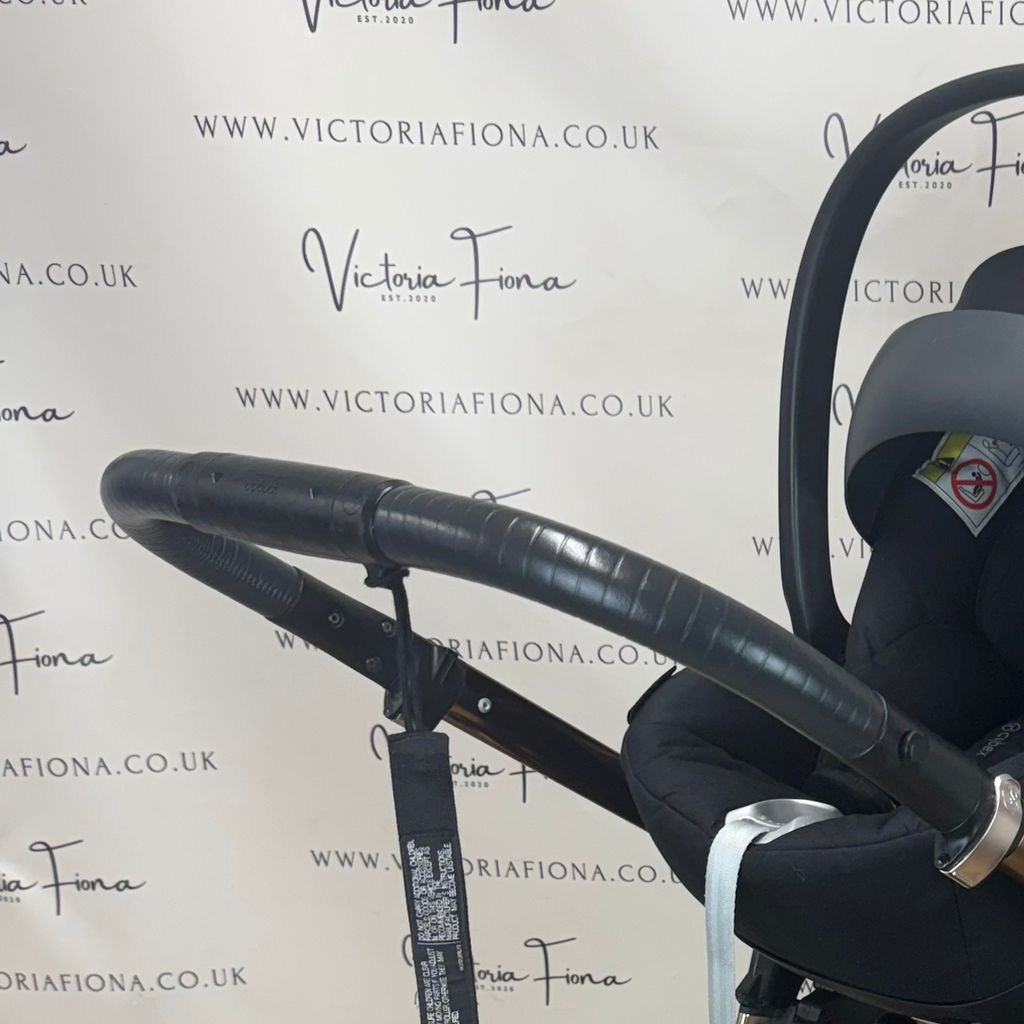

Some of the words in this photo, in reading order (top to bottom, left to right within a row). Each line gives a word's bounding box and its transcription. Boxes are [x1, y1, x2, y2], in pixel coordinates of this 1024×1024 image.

[194, 114, 660, 150] WWW.VICTORIAFIONA.CO.UK
[899, 181, 953, 189] EST.2020
[302, 228, 456, 312] Victoria
[450, 225, 577, 320] Fiona
[381, 295, 437, 303] EST.2020
[235, 387, 674, 418] WWW.VICTORIAFIONA.CO.UK
[0, 611, 112, 695] Fiona
[29, 839, 146, 916] Fiona
[524, 938, 632, 1006] Fiona
